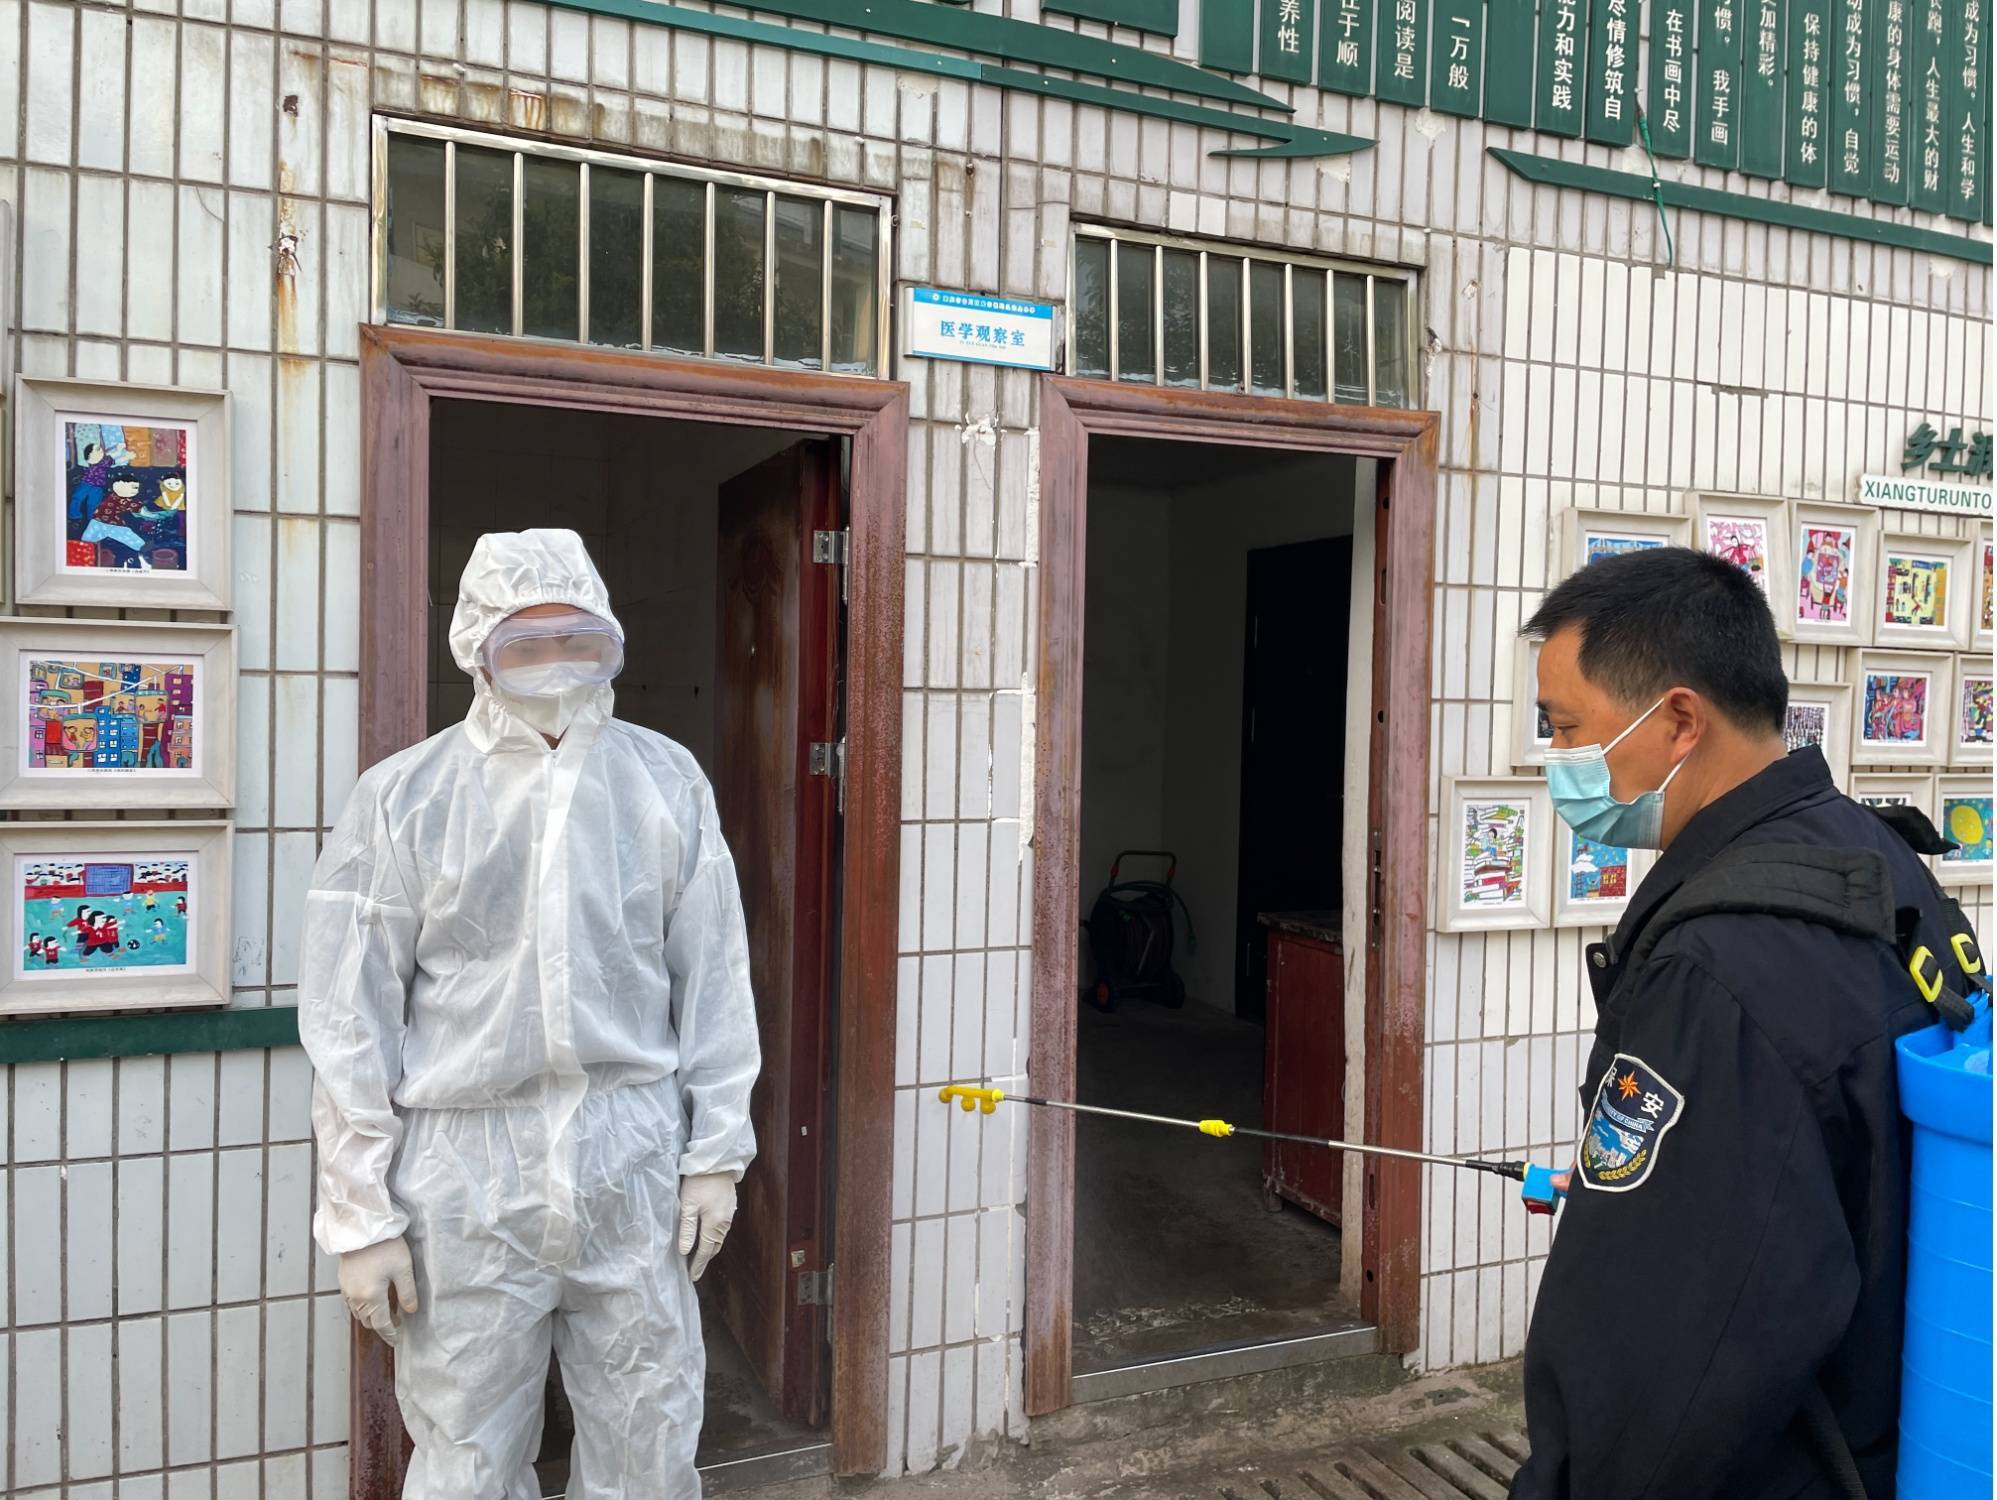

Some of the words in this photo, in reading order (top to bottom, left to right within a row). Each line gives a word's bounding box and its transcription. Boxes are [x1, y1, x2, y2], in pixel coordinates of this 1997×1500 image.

[1394, 0, 1416, 79] 阅读是
[1552, 0, 1576, 110] 力和实践
[1663, 9, 1684, 133] 在书画中尽
[1711, 0, 1733, 146] 惯。我手画
[1801, 12, 1820, 165] 保持健康的体
[940, 320, 1025, 347] 医学观察室
[1865, 480, 1992, 510] XIANGTURUNTO
[1640, 1091, 1664, 1119] 安
